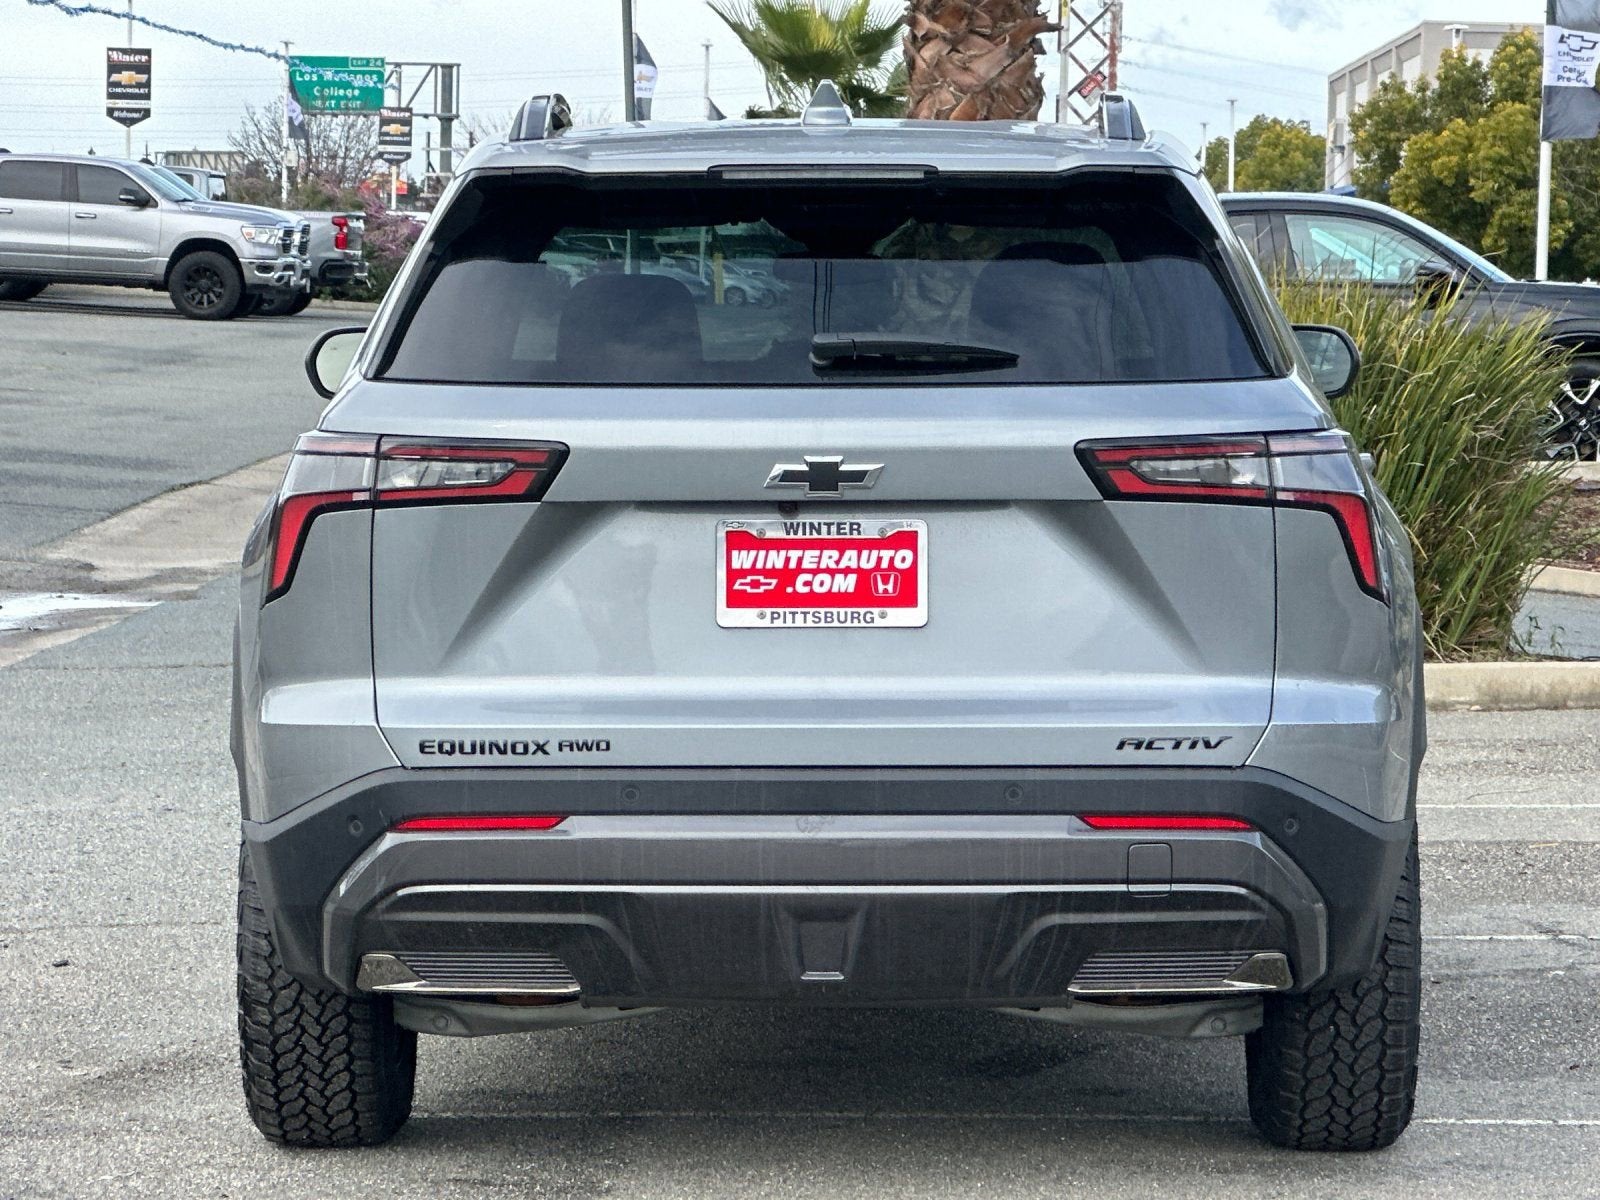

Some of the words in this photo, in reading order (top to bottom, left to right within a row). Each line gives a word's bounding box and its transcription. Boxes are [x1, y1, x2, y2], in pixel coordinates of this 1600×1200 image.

[295, 71, 318, 81] Los
[313, 86, 360, 98] College
[313, 100, 336, 108] NEXT
[340, 100, 361, 108] EXIT
[783, 521, 862, 536] WINTER
[731, 549, 914, 570] WINTERAUTO
[785, 573, 858, 594] .COM
[770, 610, 875, 625] PITTSBURG
[418, 739, 551, 756] EQUINOX
[557, 738, 611, 752] AWD
[1115, 736, 1233, 750] ACTIV
